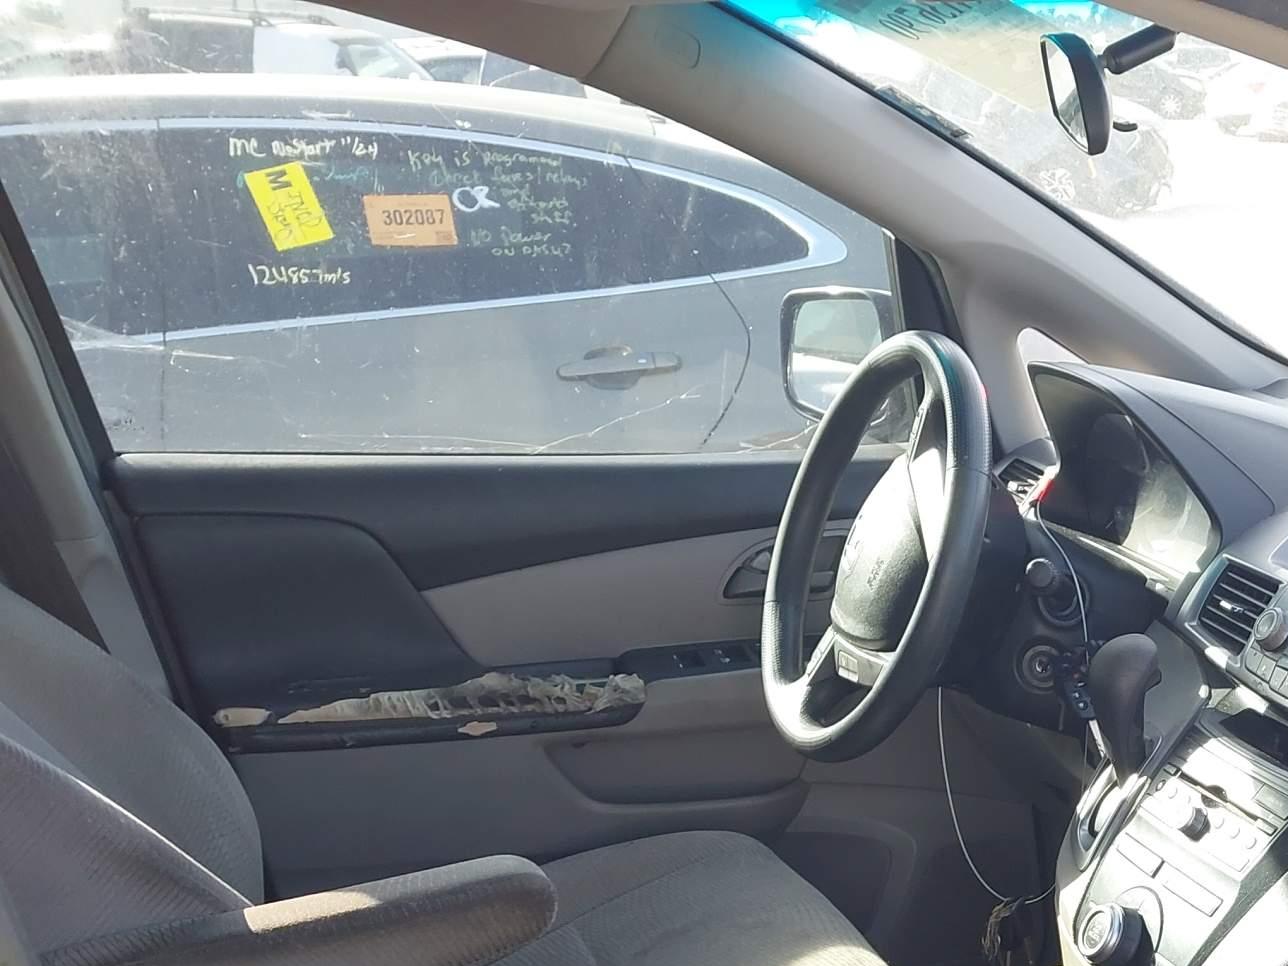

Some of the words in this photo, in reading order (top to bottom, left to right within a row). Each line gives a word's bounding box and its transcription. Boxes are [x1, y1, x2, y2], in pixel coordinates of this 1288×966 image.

[453, 150, 471, 167] is
[265, 169, 292, 191] M
[382, 208, 445, 226] 302087
